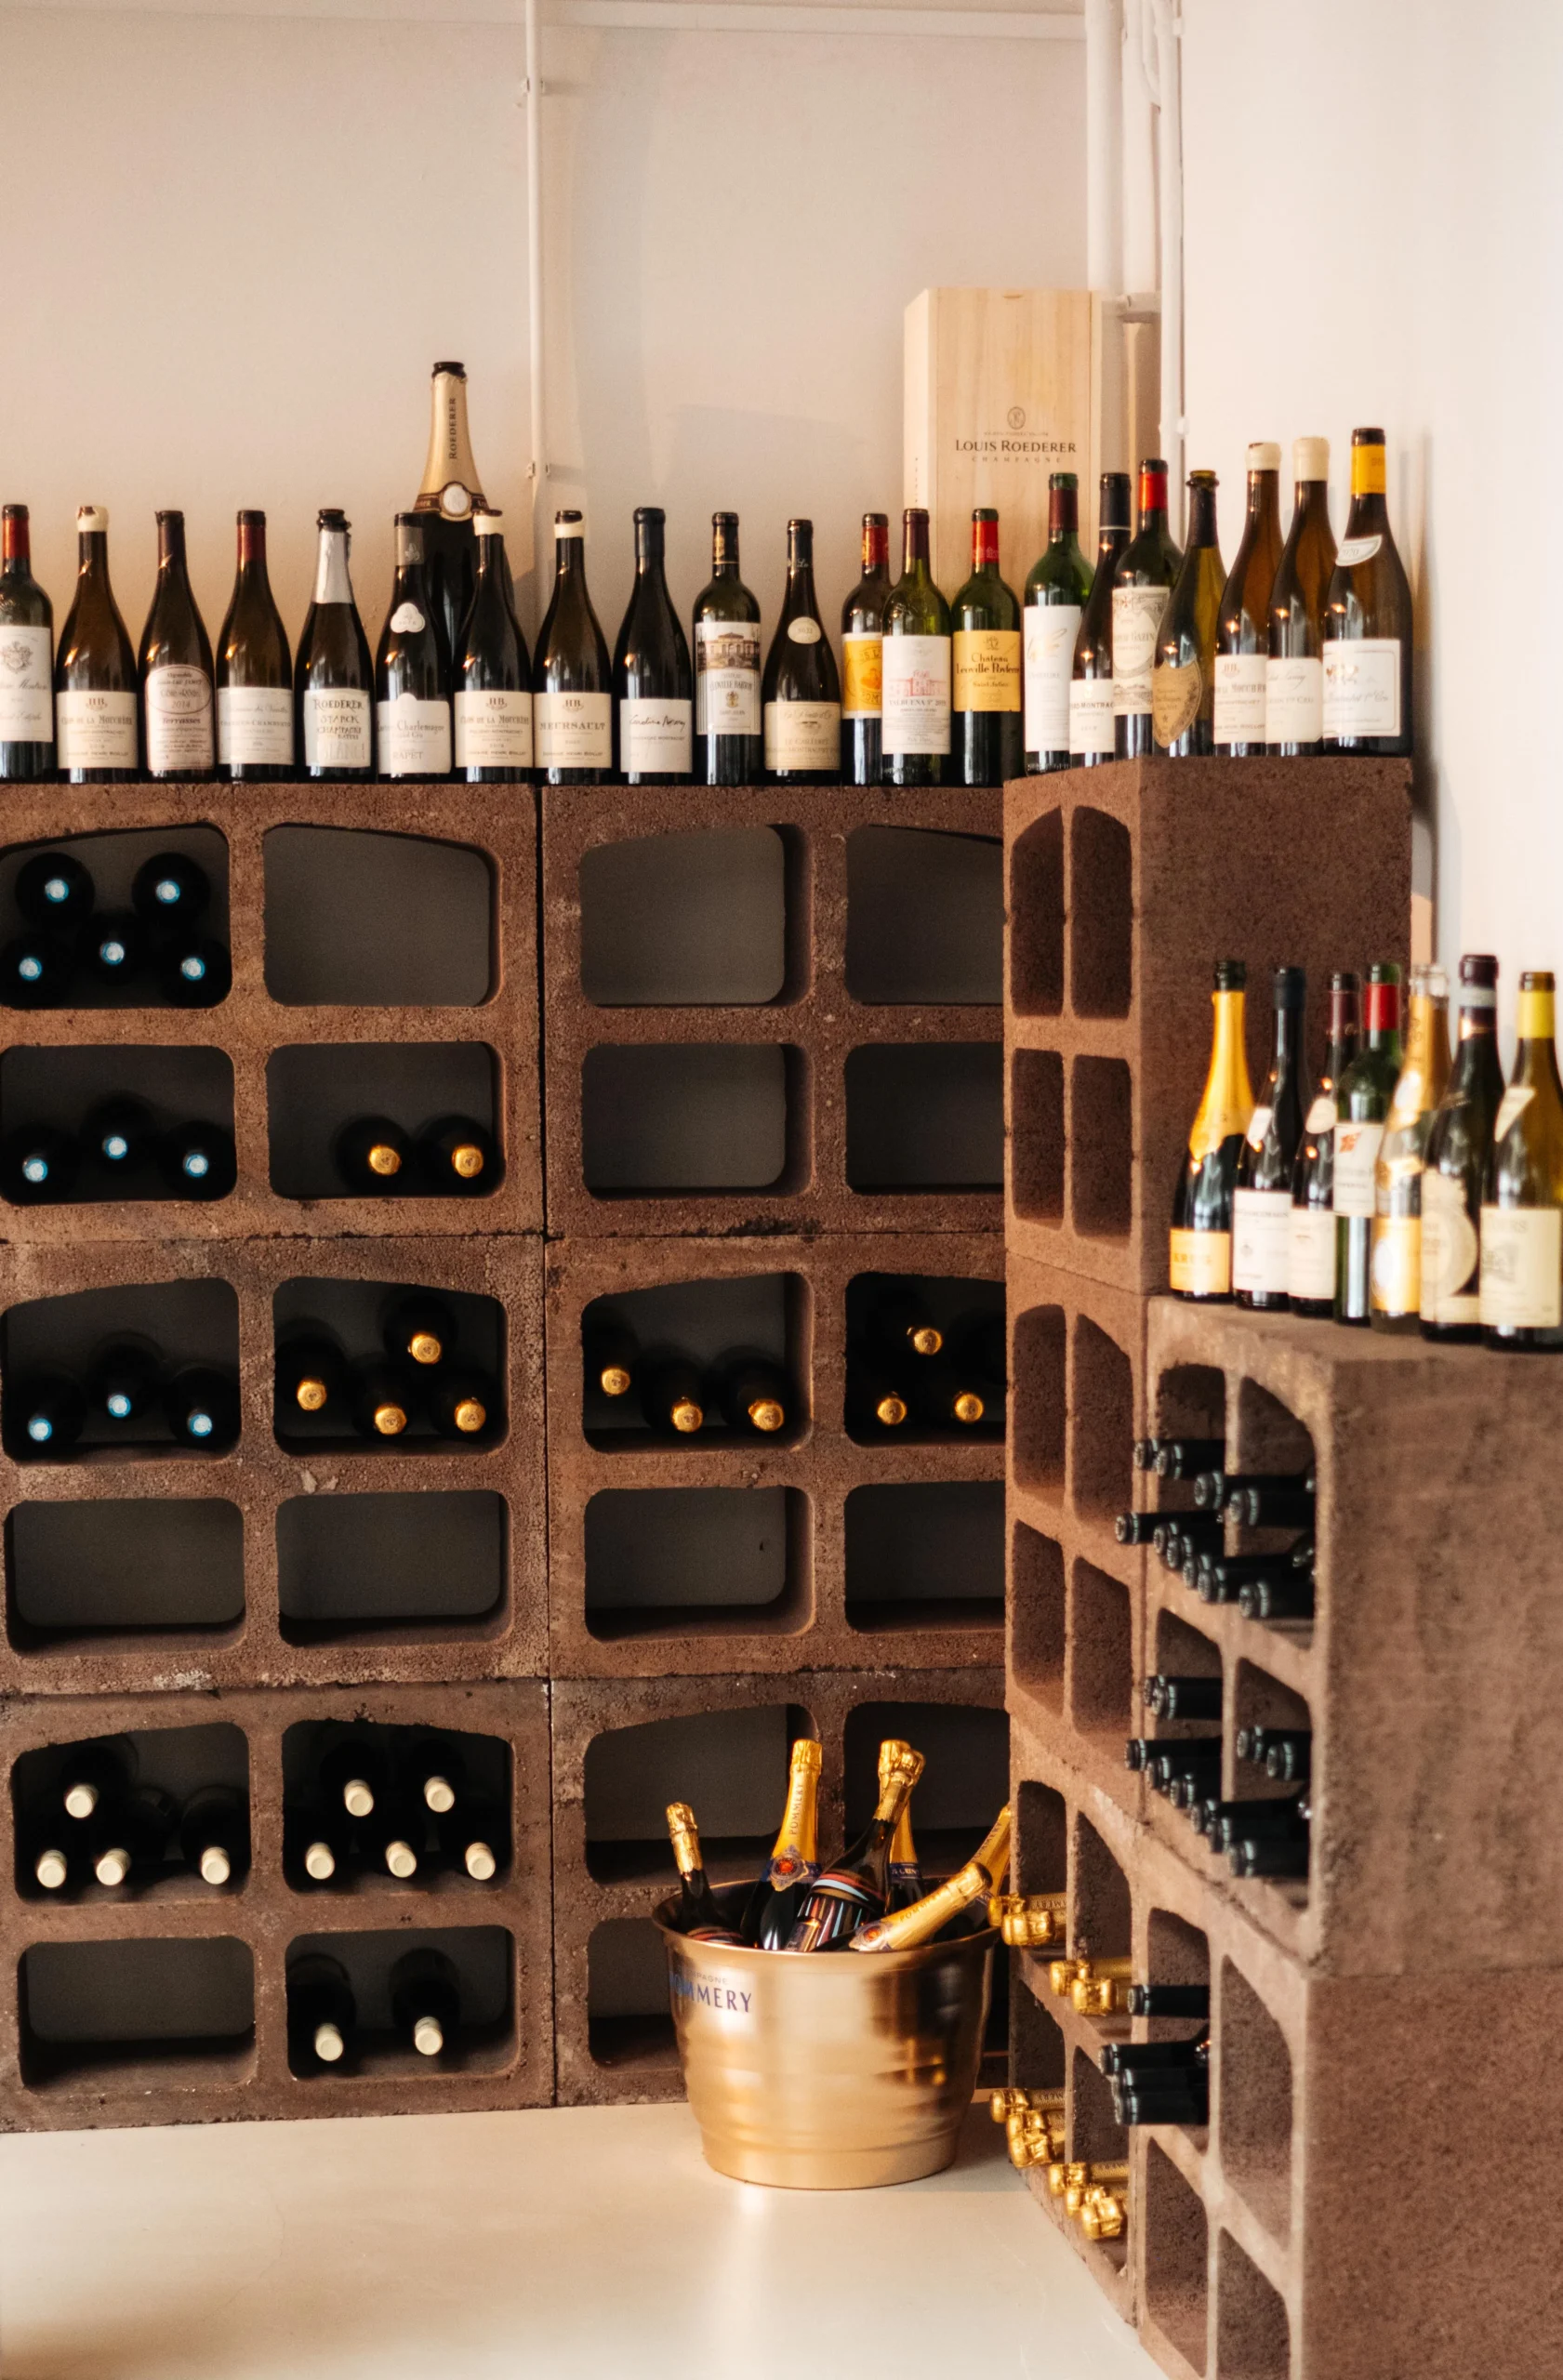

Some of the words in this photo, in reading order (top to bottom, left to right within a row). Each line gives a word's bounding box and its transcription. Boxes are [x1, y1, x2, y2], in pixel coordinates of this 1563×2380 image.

[955, 439, 997, 452] LOUIS
[1000, 440, 1077, 453] ROEDERER
[312, 698, 365, 713] ROEDERER
[397, 719, 445, 734] Charlemagne
[539, 721, 606, 731] MEURSAULT
[788, 1783, 803, 1835] POMMERY
